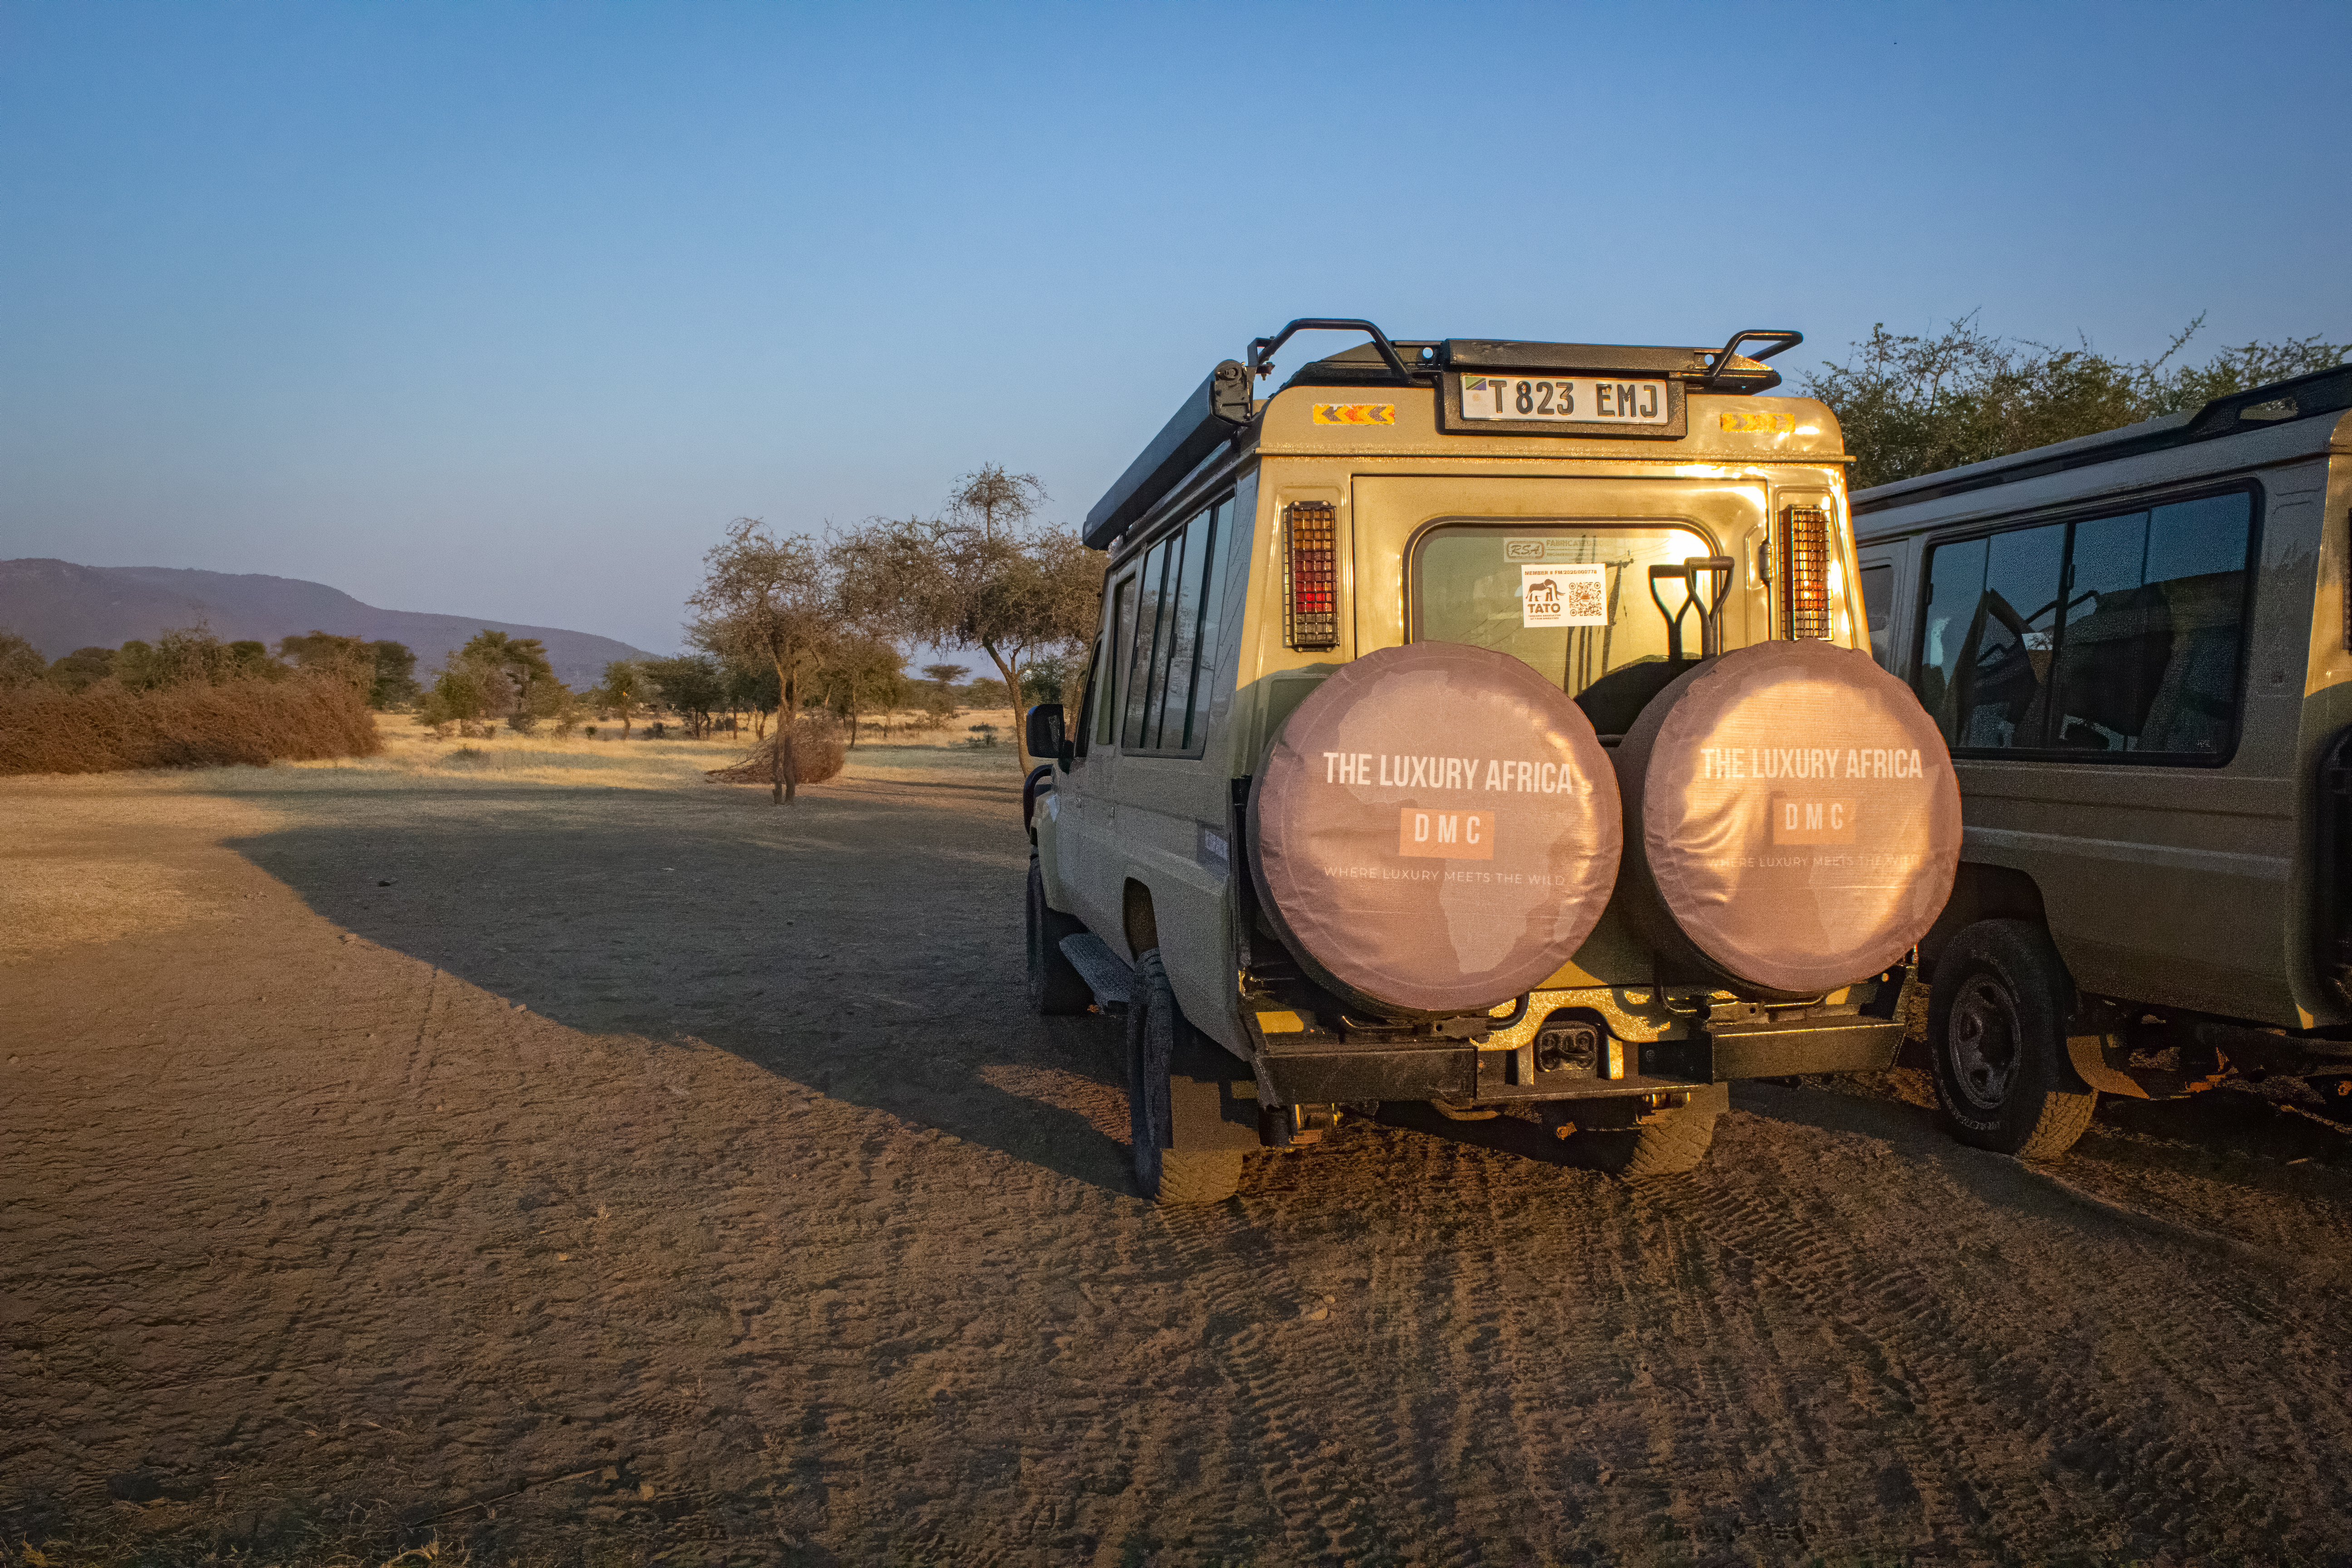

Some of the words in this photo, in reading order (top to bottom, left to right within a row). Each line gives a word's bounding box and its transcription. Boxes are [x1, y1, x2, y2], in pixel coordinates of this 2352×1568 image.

[1489, 380, 1507, 413] T
[1516, 381, 1574, 416] 823
[1596, 383, 1658, 418] EMJ
[1510, 544, 1541, 555] RSA
[1527, 603, 1561, 613] TATO
[1323, 752, 1371, 785] THE
[1380, 755, 1480, 789] LUXURY
[1485, 760, 1573, 794] AFRICA
[1700, 749, 1745, 779] THE
[1753, 748, 1840, 779] LUXURY
[1845, 749, 1923, 779] AFRICA
[1708, 857, 1754, 868] WHERE
[1759, 857, 1808, 867] LUXURY
[1813, 856, 1854, 867] MEETS
[1323, 866, 1378, 879] WHERE
[1382, 869, 1440, 881] LUXURY
[1444, 872, 1490, 883] MEETS
[1494, 873, 1522, 884] THE
[1528, 874, 1565, 886] WILD
